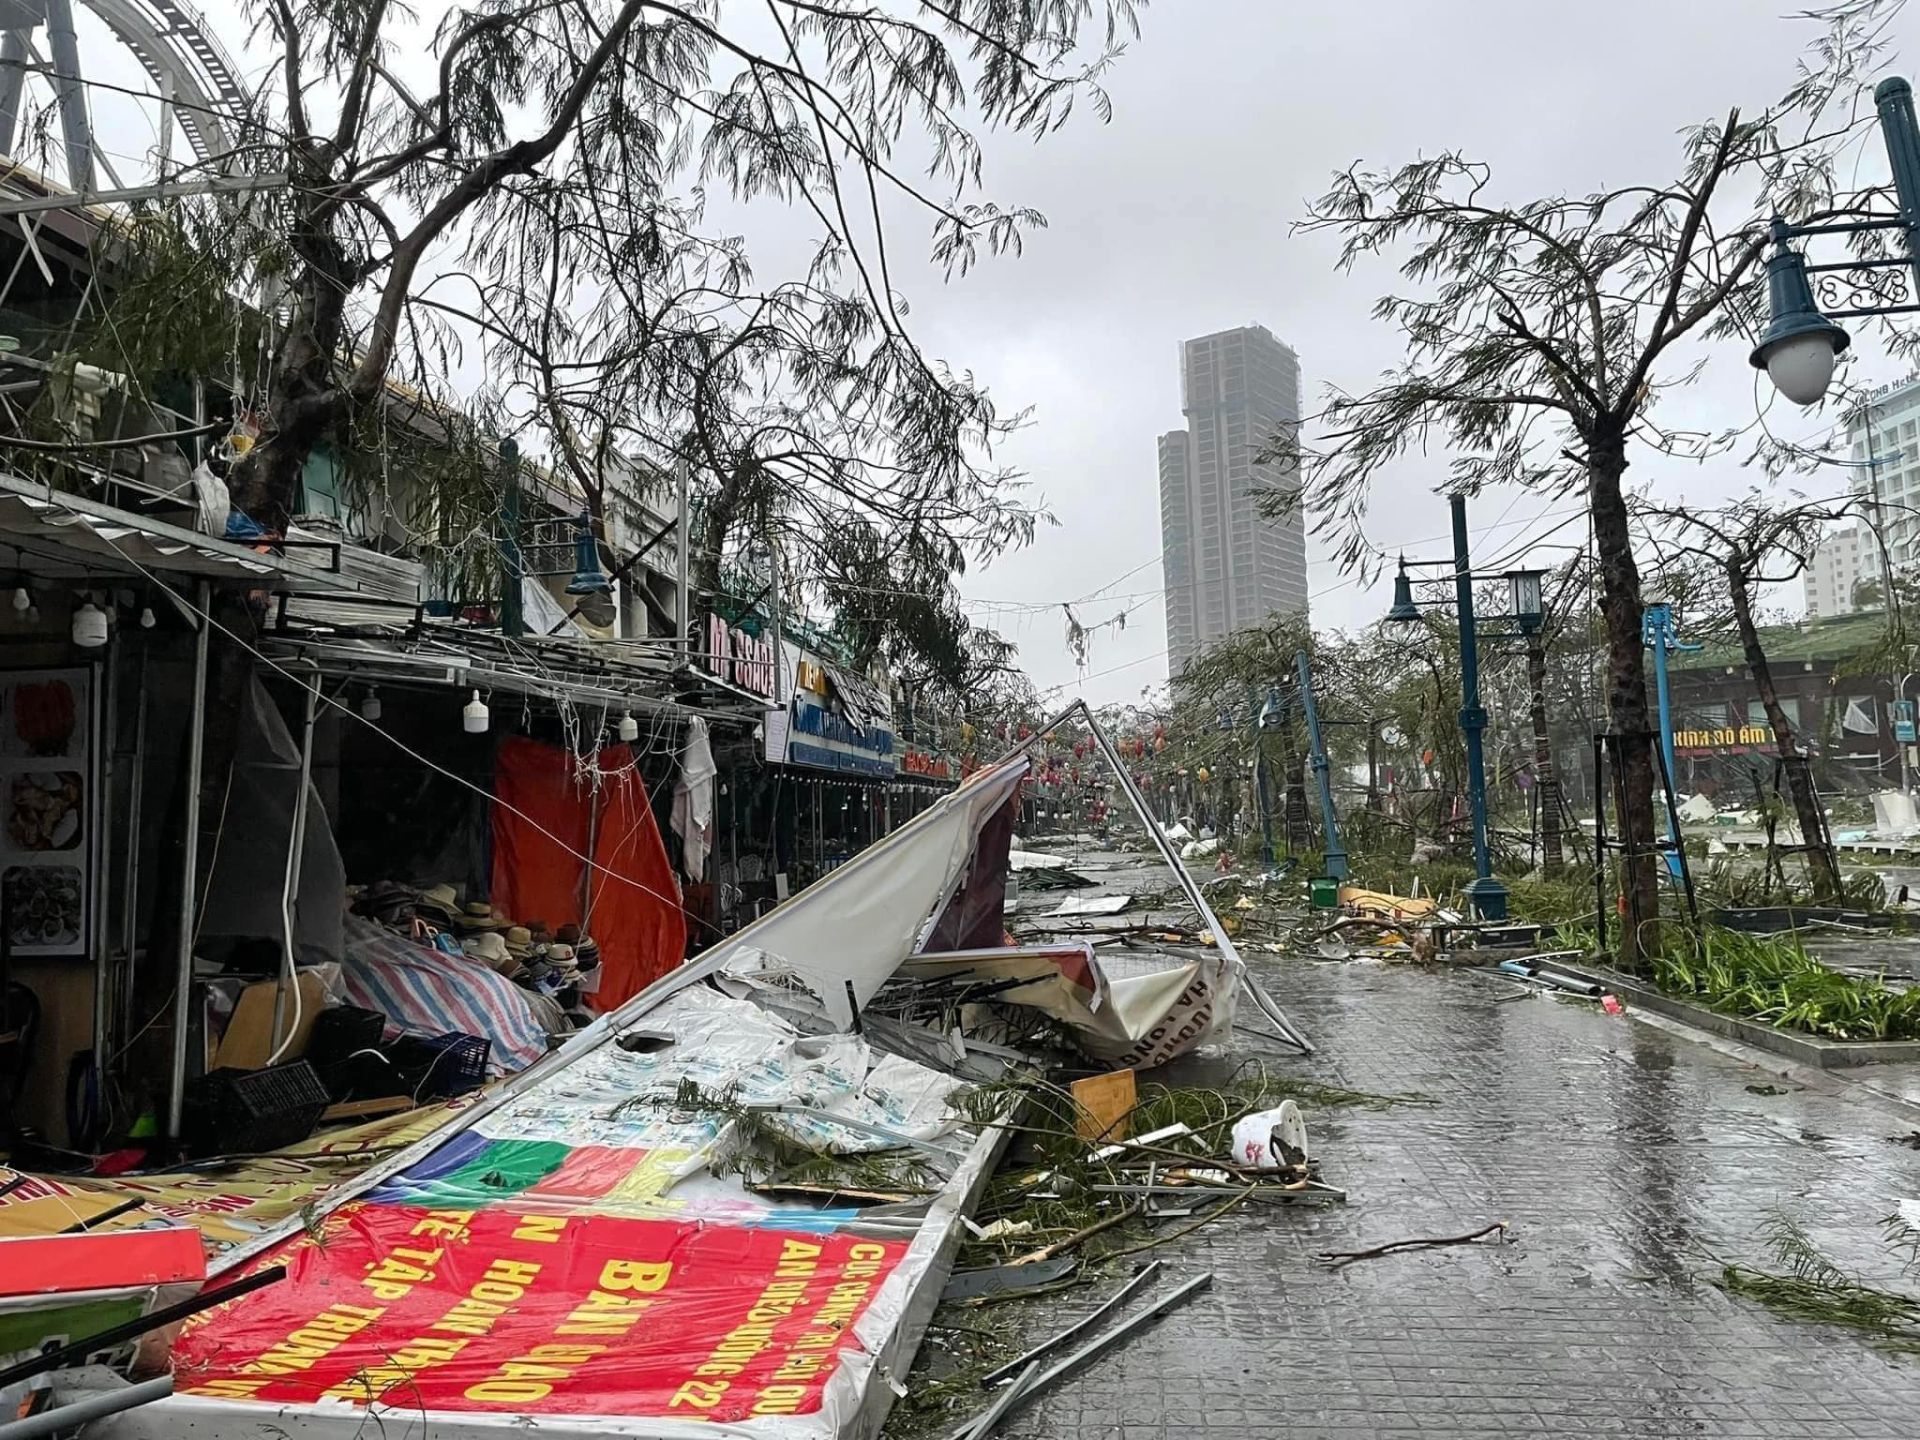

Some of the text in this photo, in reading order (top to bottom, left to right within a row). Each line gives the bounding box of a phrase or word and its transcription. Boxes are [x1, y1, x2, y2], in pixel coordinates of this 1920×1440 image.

[361, 1247, 445, 1300] TẬP
[774, 1239, 822, 1277] AN
[838, 1243, 885, 1279] CỤC
[432, 1259, 543, 1335] HOÀN
[811, 1281, 871, 1325] CHÍNH
[463, 1259, 673, 1403] BÀN GIAO
[668, 1381, 730, 1408] 22
[751, 1384, 807, 1418] QU
